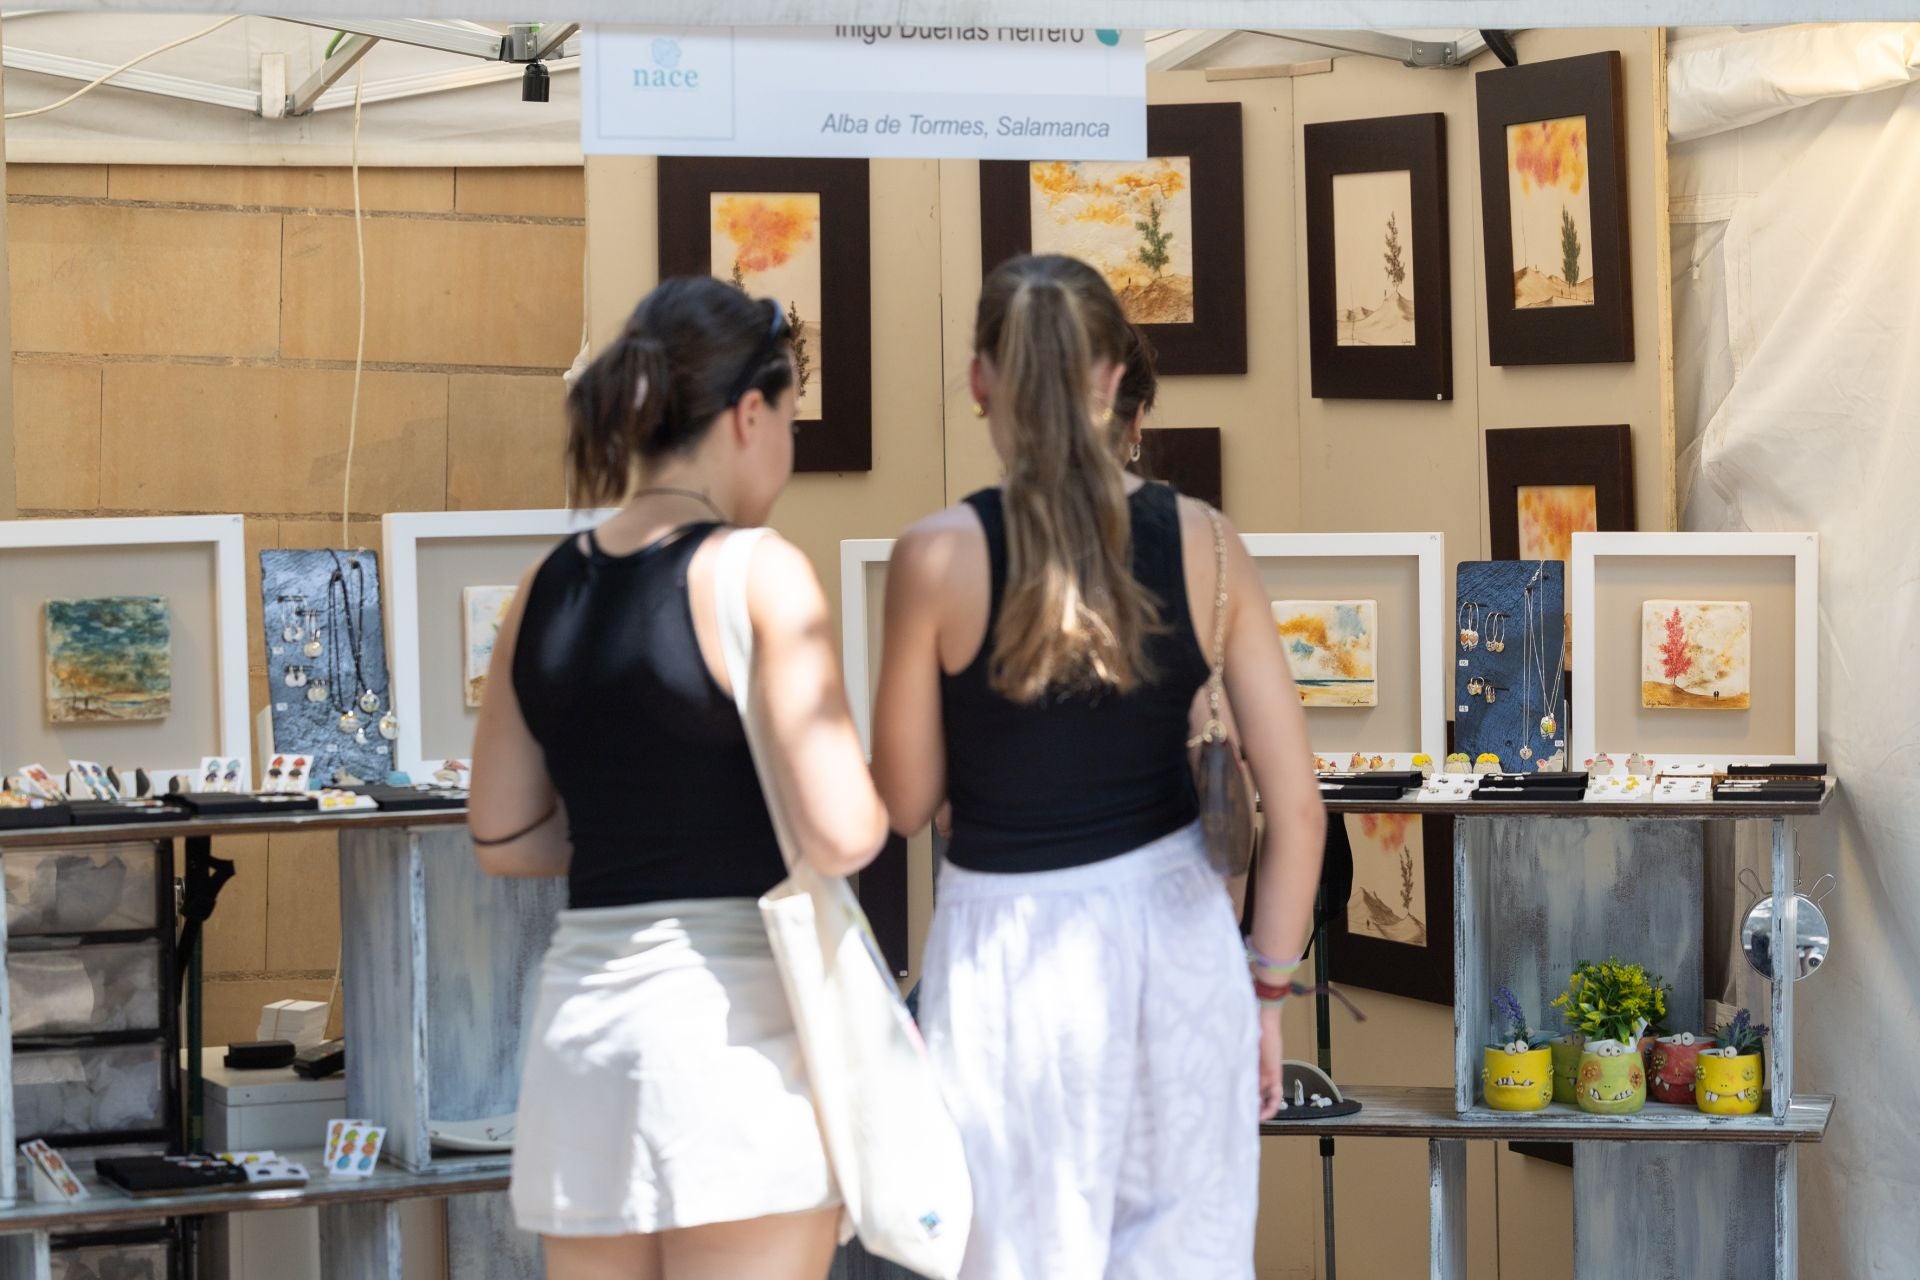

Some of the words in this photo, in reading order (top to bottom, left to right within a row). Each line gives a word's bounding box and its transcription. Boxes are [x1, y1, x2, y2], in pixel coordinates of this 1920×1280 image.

[633, 68, 699, 87] nace
[820, 113, 869, 134] Alba
[875, 114, 901, 135] de
[910, 114, 988, 139] Tormes,
[997, 115, 1110, 137] Salamanca
